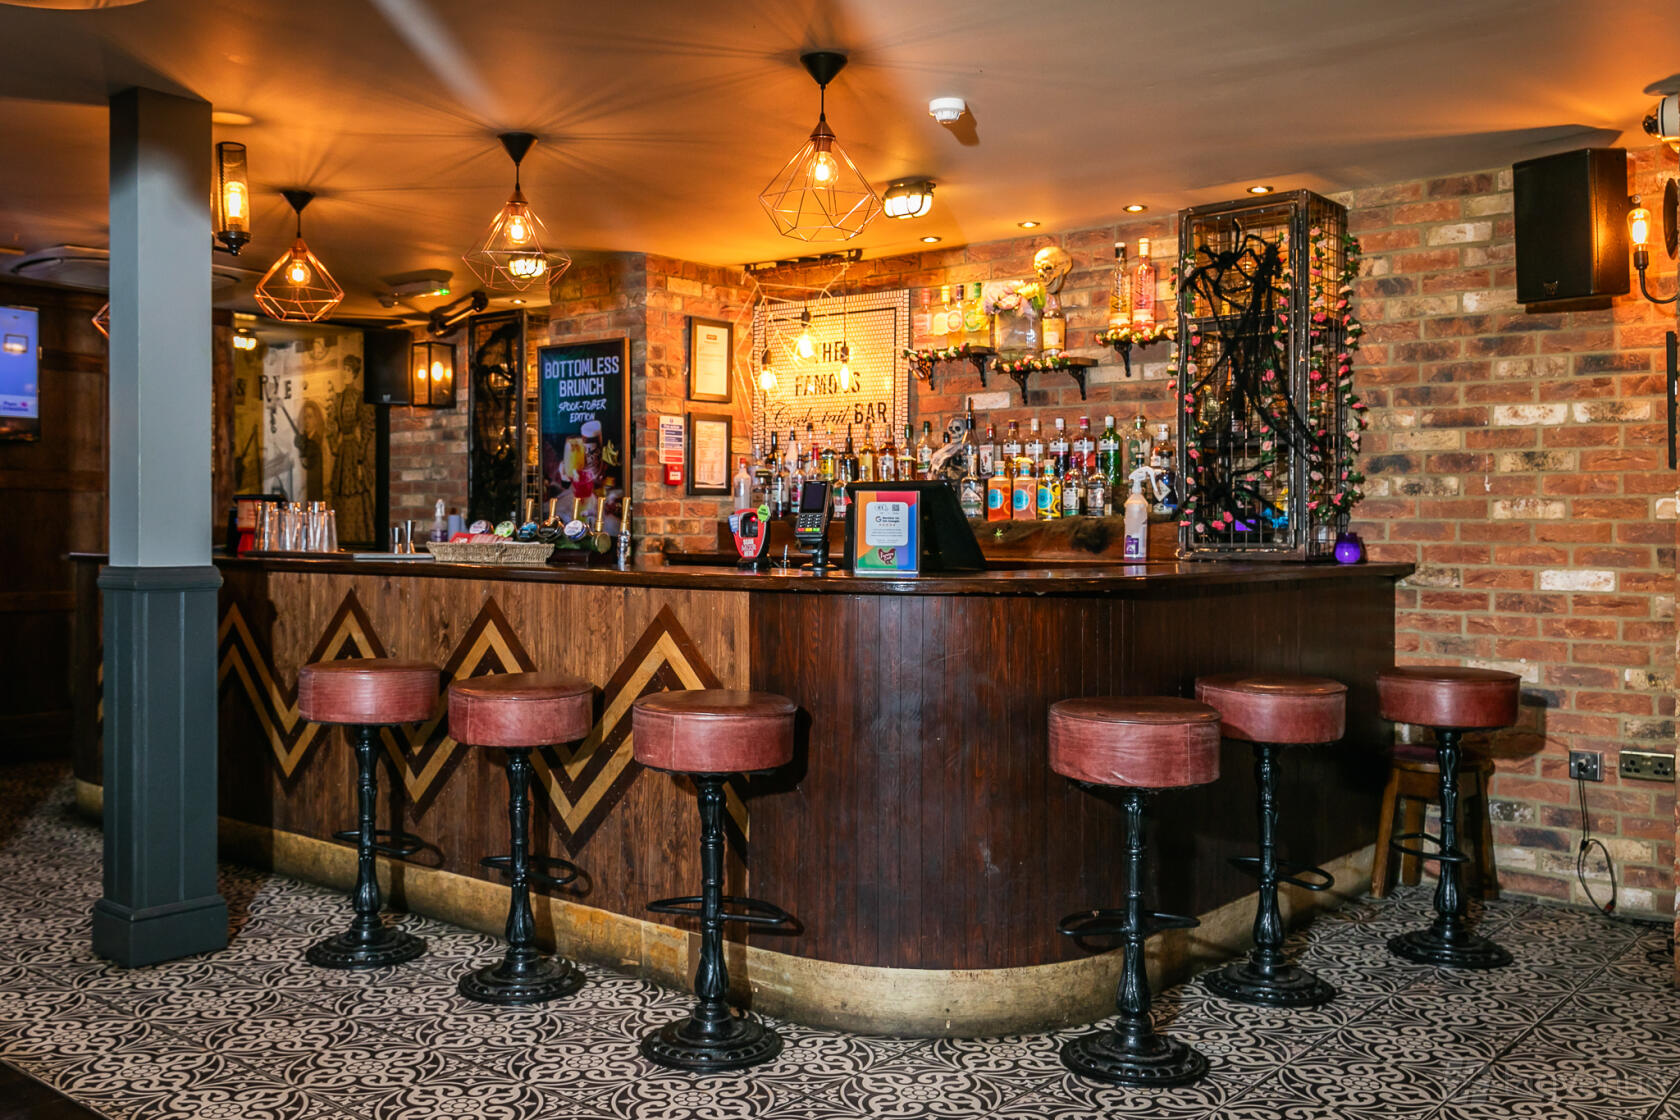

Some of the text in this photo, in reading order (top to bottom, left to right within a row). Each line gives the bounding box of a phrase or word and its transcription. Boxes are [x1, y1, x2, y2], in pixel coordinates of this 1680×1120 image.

[544, 356, 620, 379] BOTTOMLESS
[559, 378, 605, 398] BRUNCH
[795, 371, 861, 397] FAMOS
[557, 398, 607, 415] SPOOK-TOBER
[854, 402, 887, 425] BAR
[569, 412, 596, 424] EDITION
